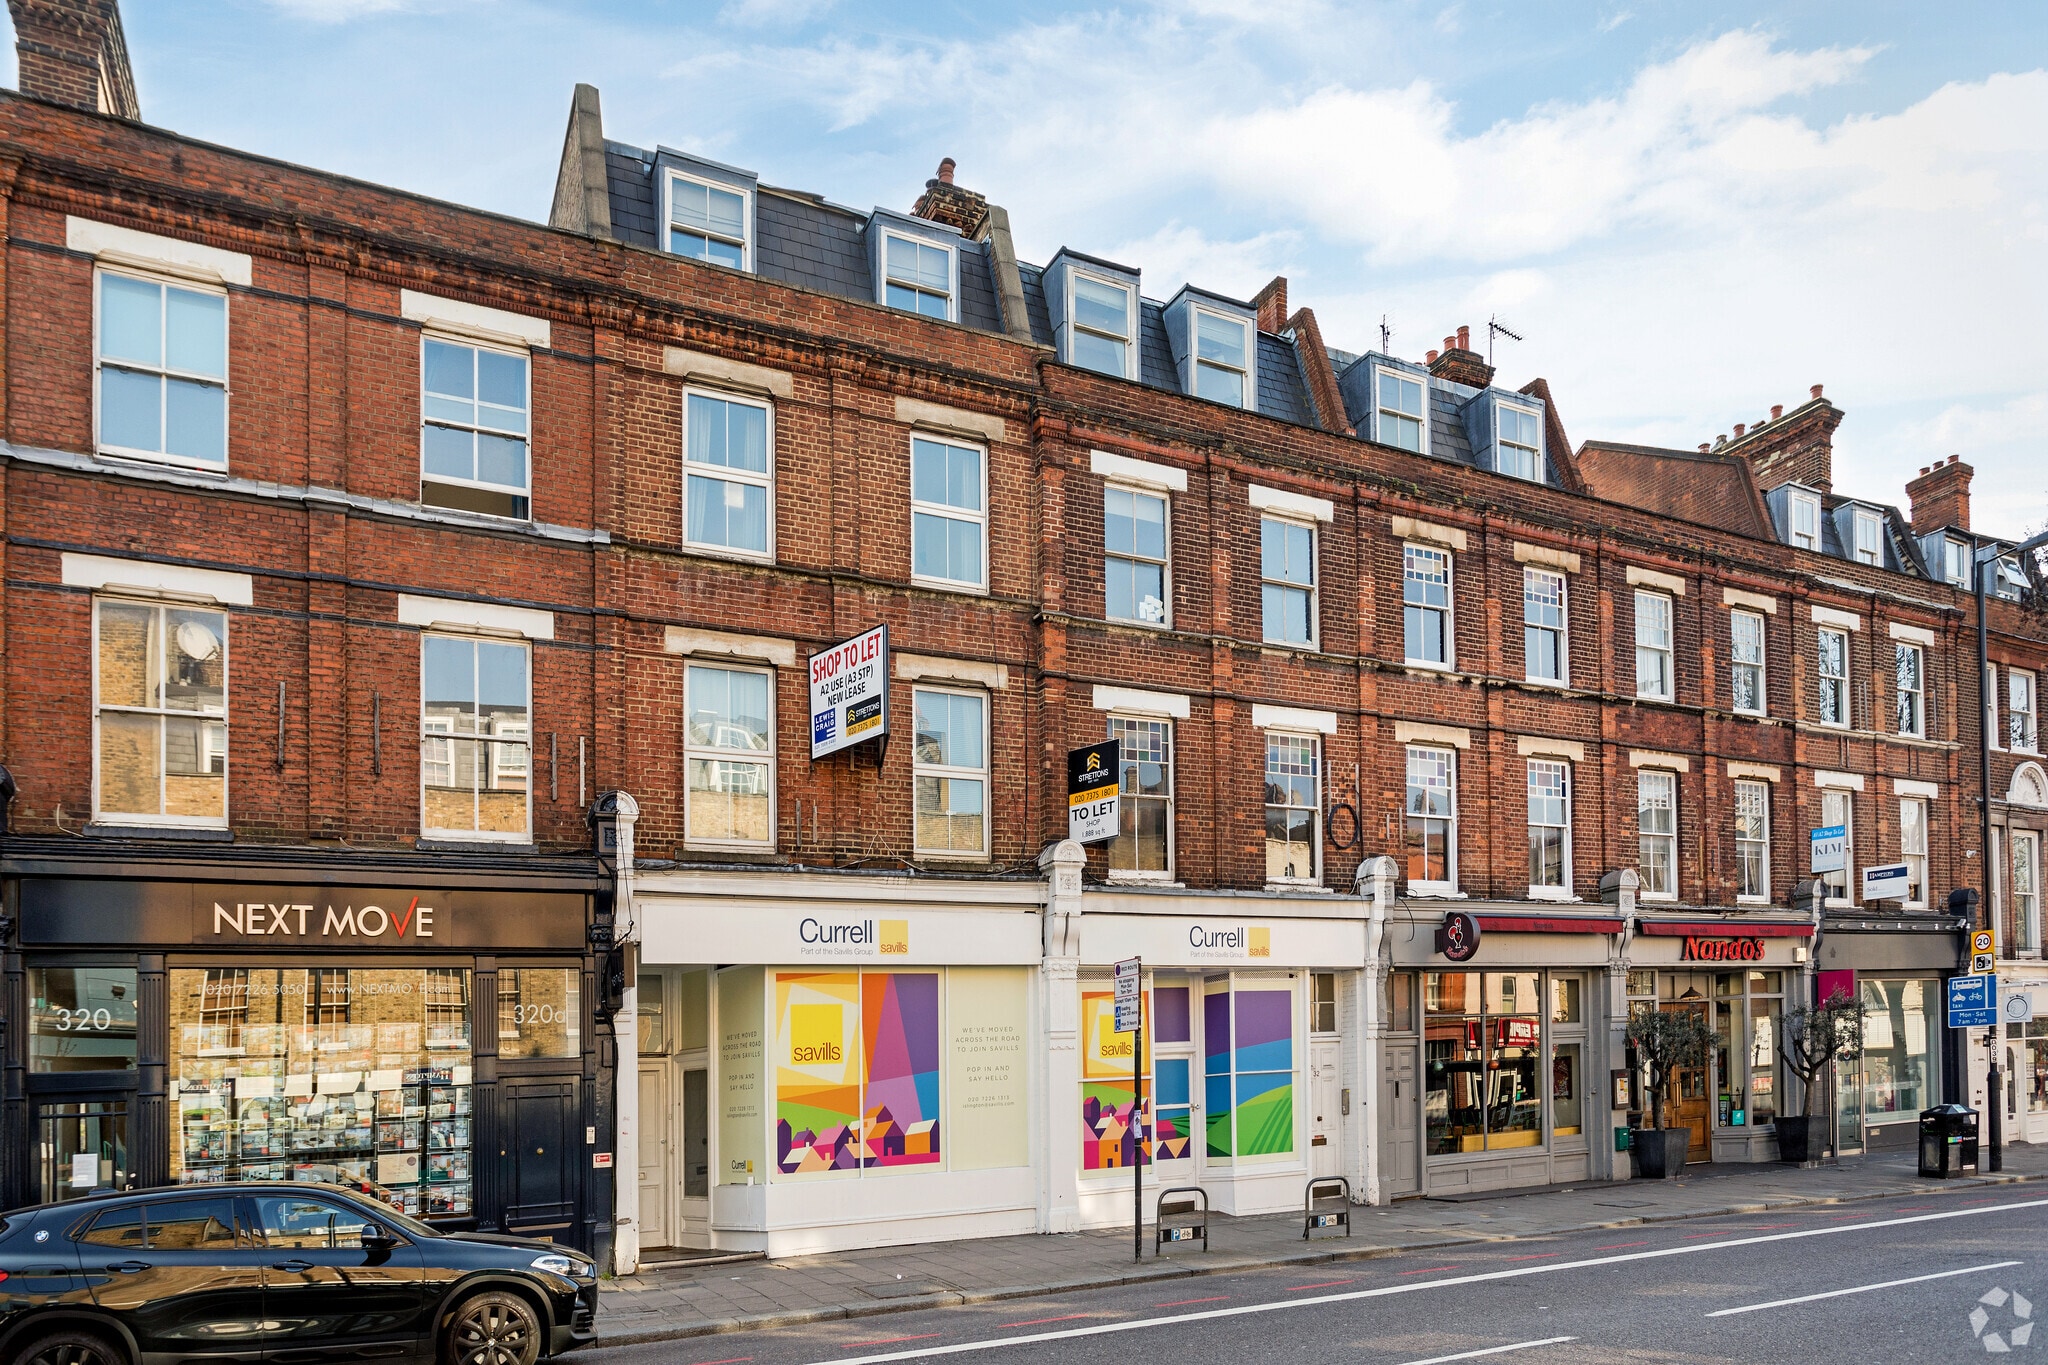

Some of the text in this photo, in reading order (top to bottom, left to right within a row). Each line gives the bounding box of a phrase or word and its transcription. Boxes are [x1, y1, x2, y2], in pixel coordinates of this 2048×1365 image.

[813, 632, 880, 684] SHOP TO LET
[820, 664, 874, 696] A2 USE (A3 STP)
[828, 682, 866, 708] NEW LEASE
[816, 710, 835, 724] LEWIS
[855, 702, 880, 718] STRETTONS
[816, 719, 835, 732] CRAIG
[848, 725, 857, 735] 020
[1078, 768, 1109, 782] STRETTONS
[1074, 788, 1114, 803] 020 7375 1801
[1072, 800, 1115, 821] TO LET
[1086, 818, 1100, 828] SHOP
[1815, 843, 1841, 855] KLM
[214, 896, 432, 938] NEXT MOVE
[800, 918, 872, 943] Currell
[1190, 926, 1244, 947] Currell
[880, 942, 907, 953] savills
[1684, 936, 1765, 960] Nando's
[1977, 938, 1989, 946] 20
[1249, 947, 1269, 956] savills
[206, 984, 232, 995] 020
[235, 984, 267, 995] 7226
[273, 984, 304, 995] 5050
[56, 1008, 111, 1030] 320
[794, 1042, 840, 1061] savills
[1101, 1042, 1132, 1056] savills
[732, 1160, 746, 1169] Currell
[1320, 1217, 1326, 1226] P
[1173, 1230, 1180, 1240] P
